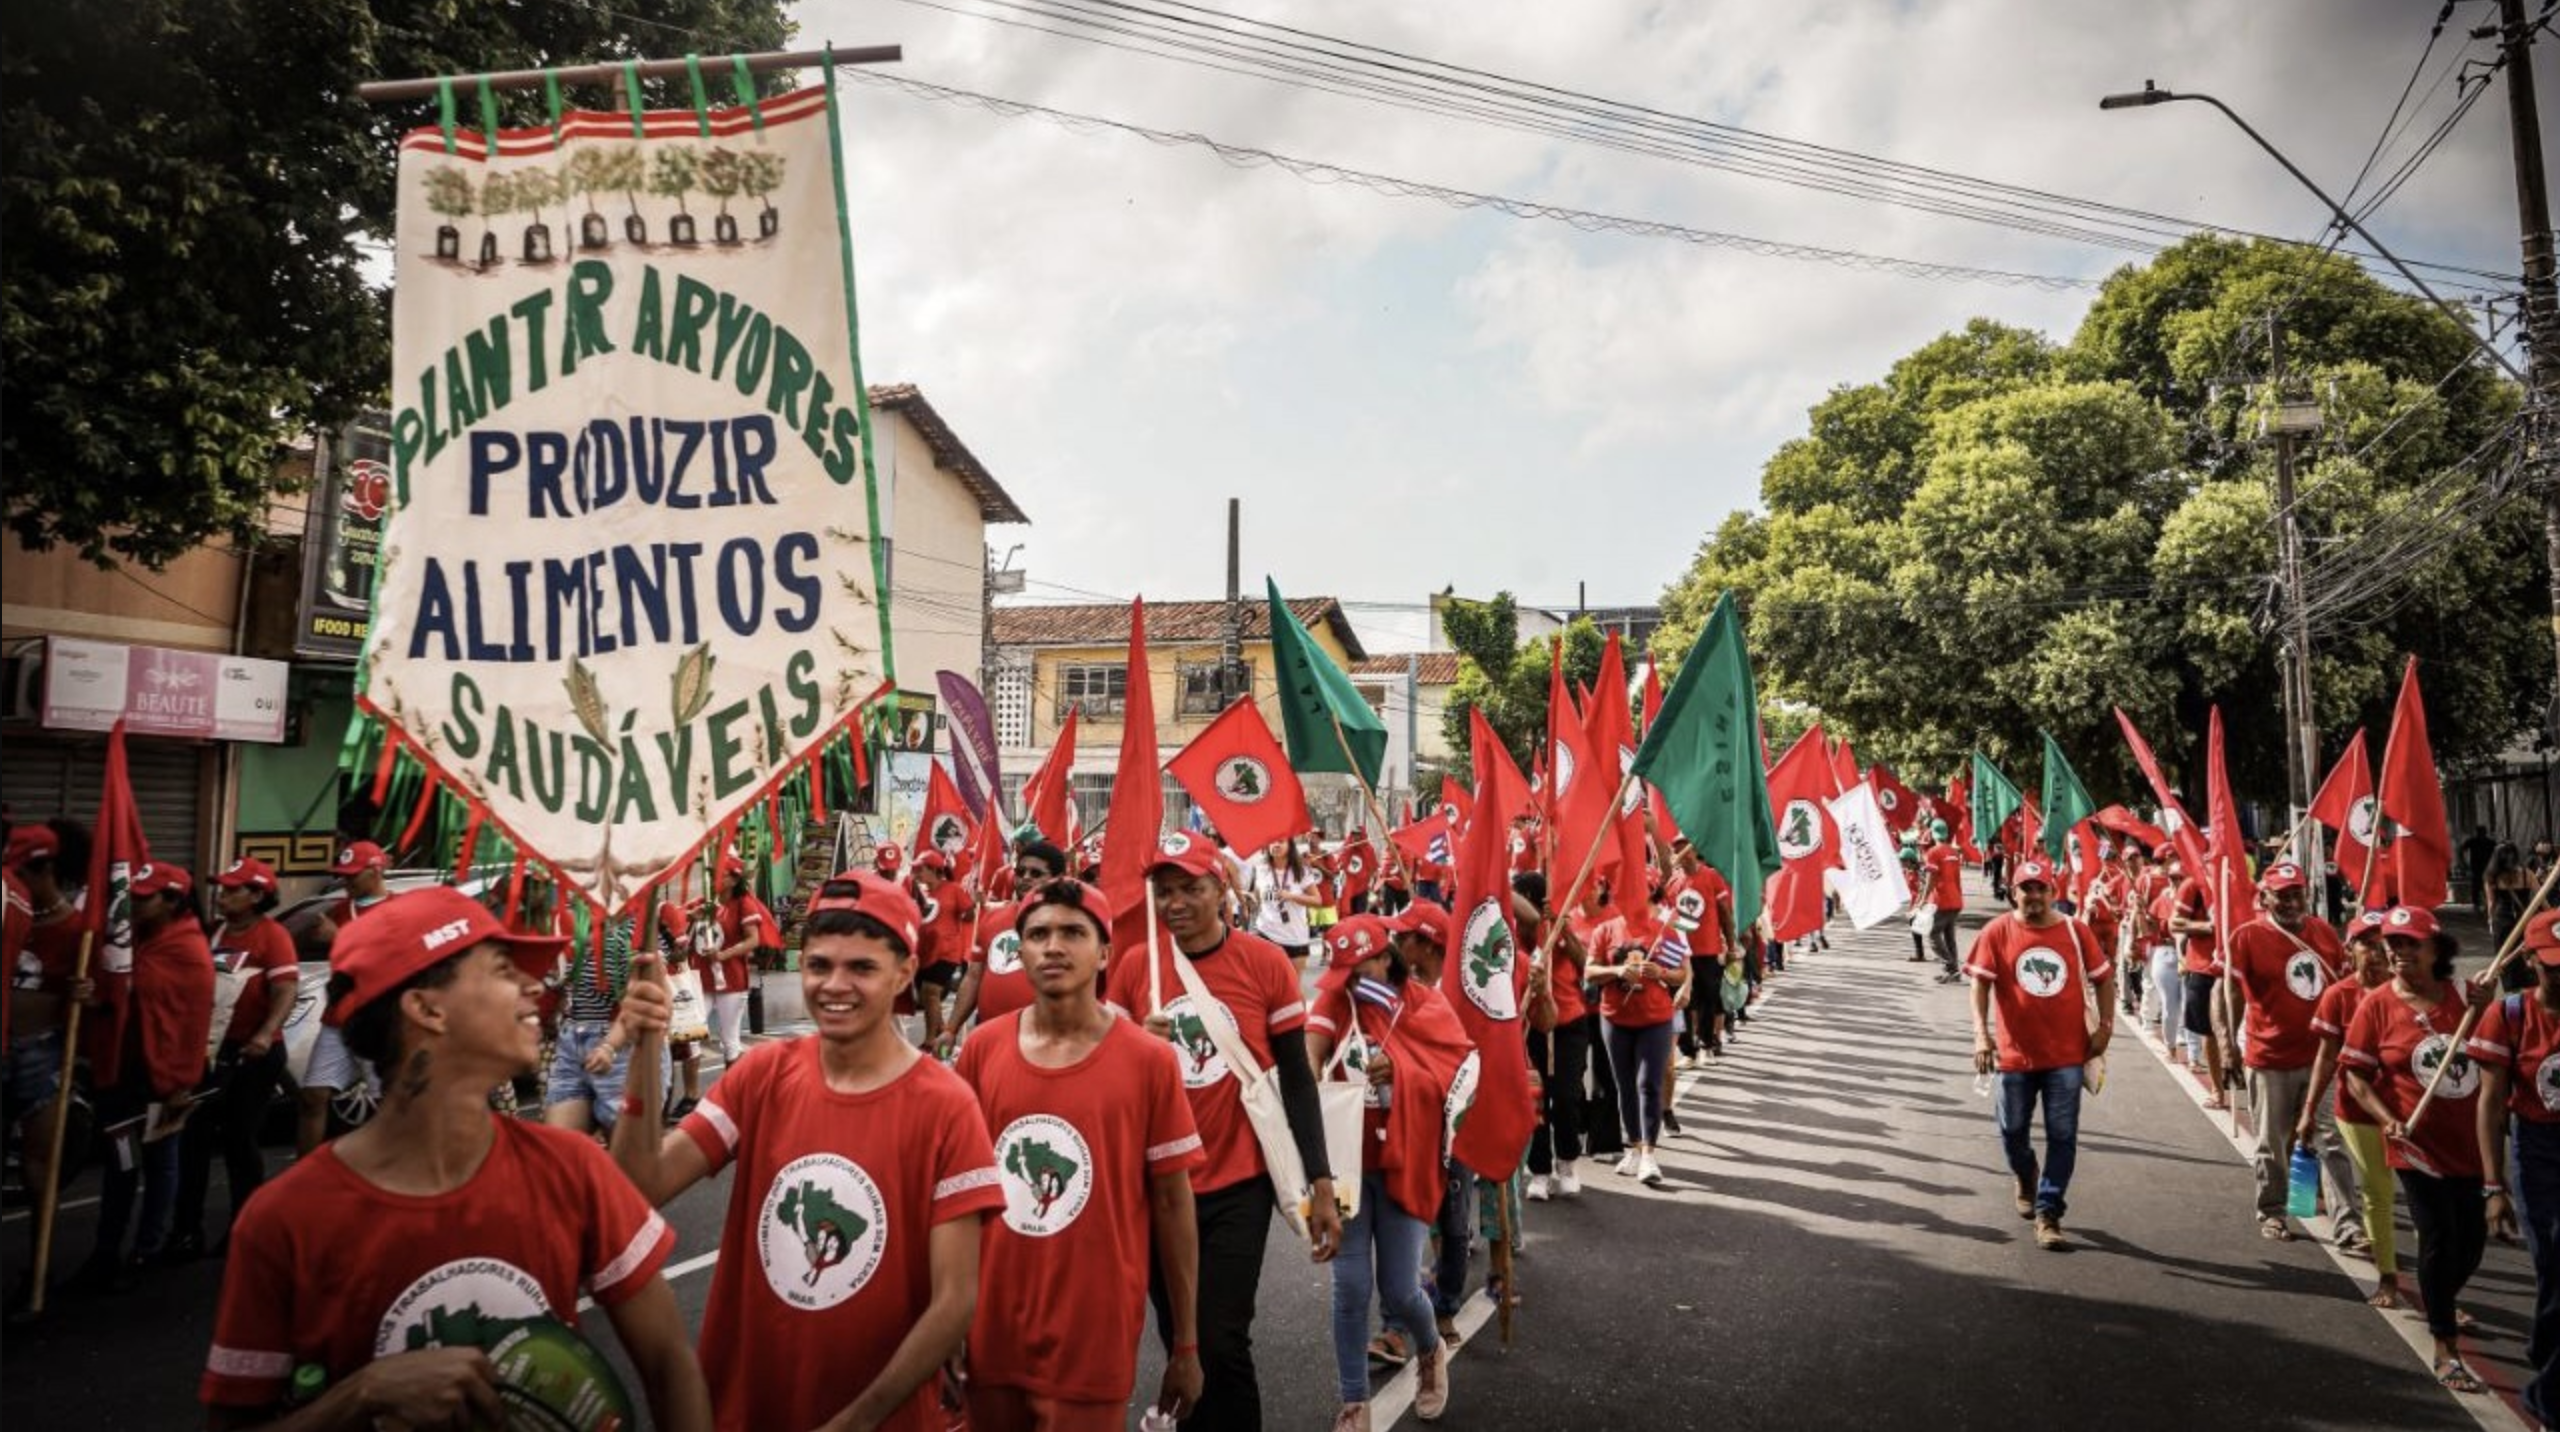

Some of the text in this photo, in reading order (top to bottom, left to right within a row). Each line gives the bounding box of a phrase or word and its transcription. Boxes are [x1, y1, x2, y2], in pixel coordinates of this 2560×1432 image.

[469, 414, 777, 518] PRODUZIR
[353, 622, 369, 639] RE
[408, 532, 822, 663] ALIMENTOS
[441, 650, 821, 825] SAUDÁVEIS
[422, 918, 470, 950] MST
[393, 1261, 516, 1317] TRABALHADORES
[516, 1276, 547, 1311] RURA
